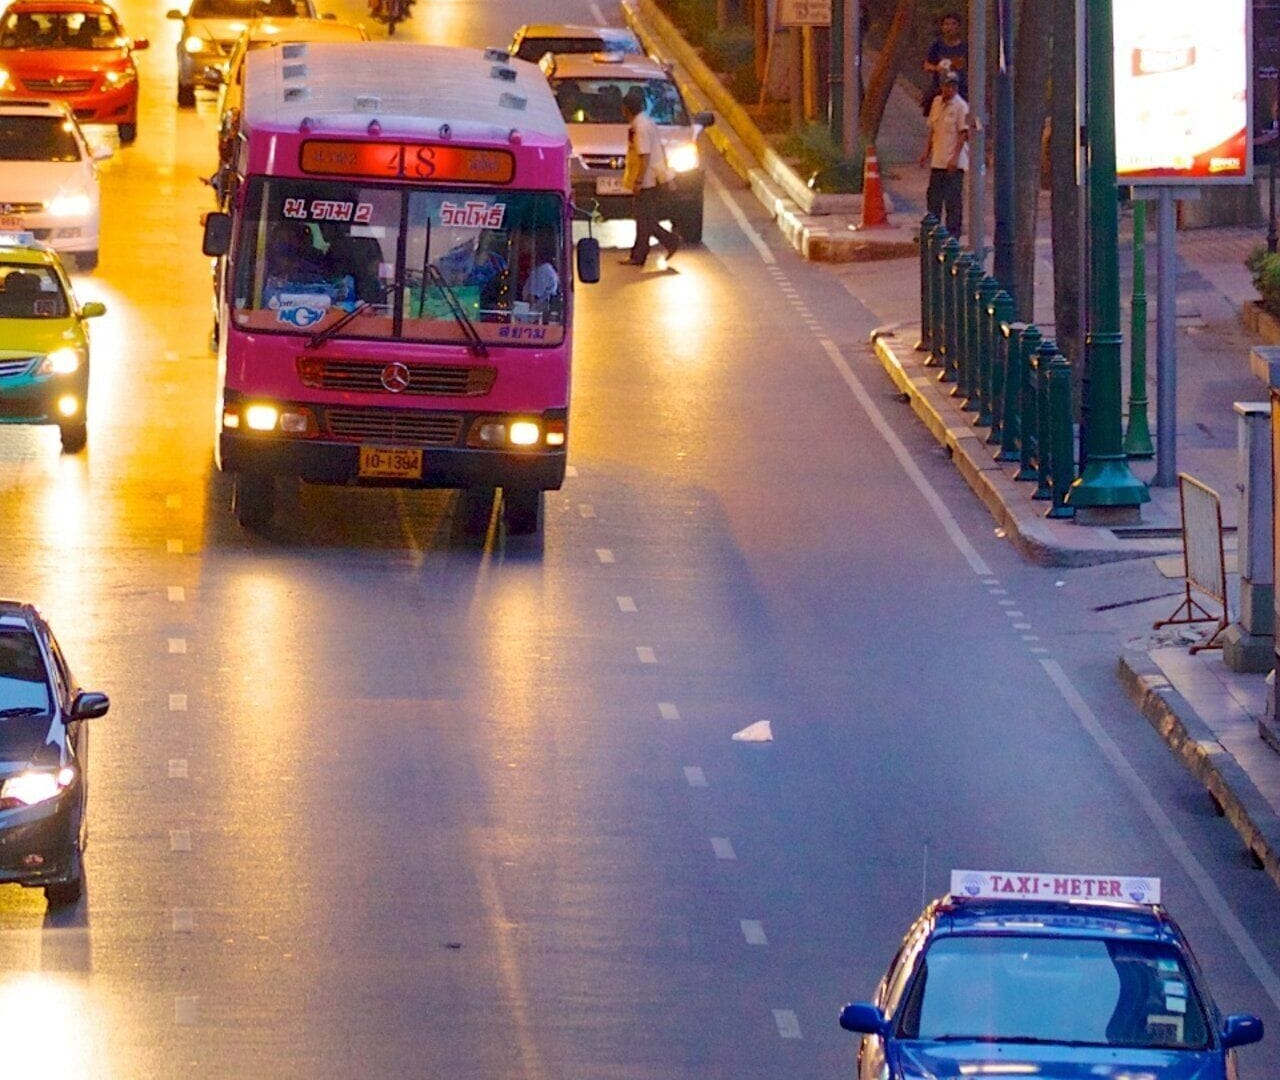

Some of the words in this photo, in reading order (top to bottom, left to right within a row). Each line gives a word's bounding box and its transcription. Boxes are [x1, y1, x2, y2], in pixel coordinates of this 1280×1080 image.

[387, 146, 436, 178] 48
[311, 201, 352, 221] ราม
[354, 203, 373, 223] 2
